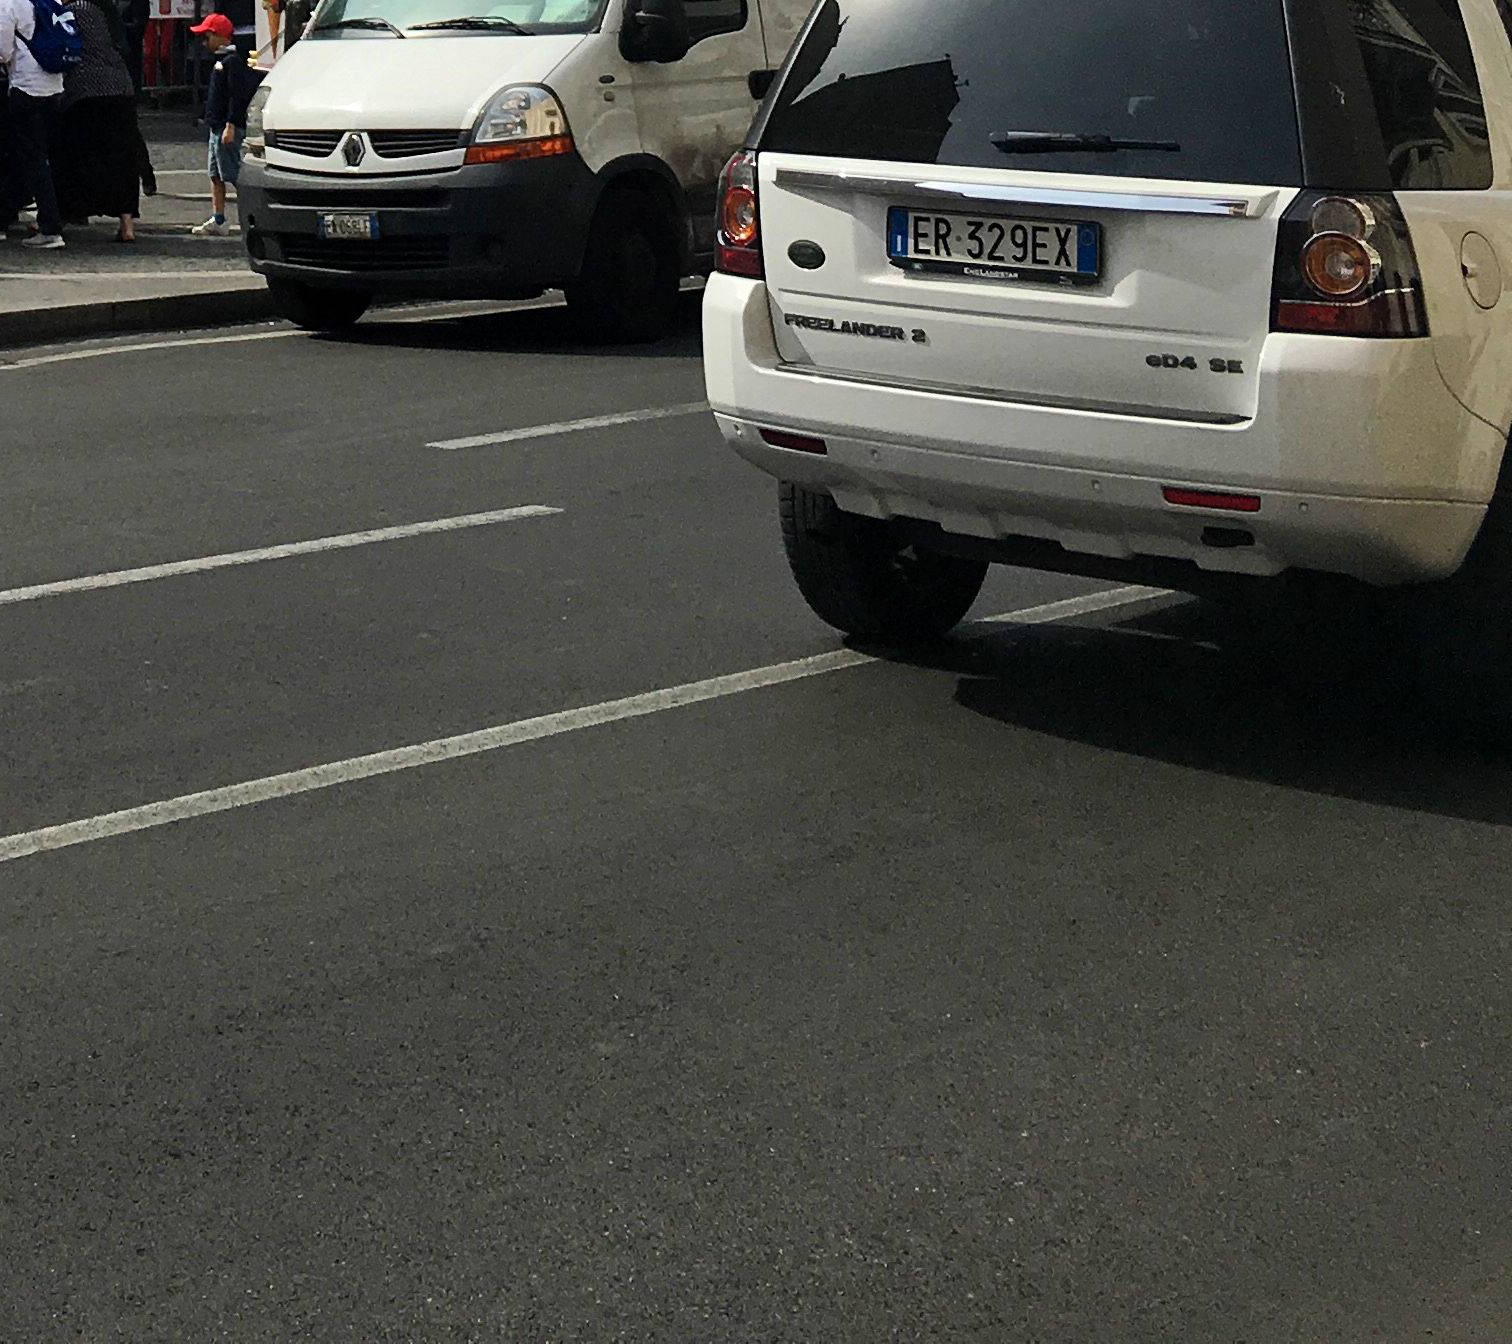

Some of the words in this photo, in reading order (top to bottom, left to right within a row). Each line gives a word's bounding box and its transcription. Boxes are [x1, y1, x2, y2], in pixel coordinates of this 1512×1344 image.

[913, 215, 952, 257] ER
[966, 220, 1072, 267] 329EX
[784, 313, 907, 340] FREELANDER
[911, 328, 927, 343] 2
[1208, 357, 1244, 374] SE
